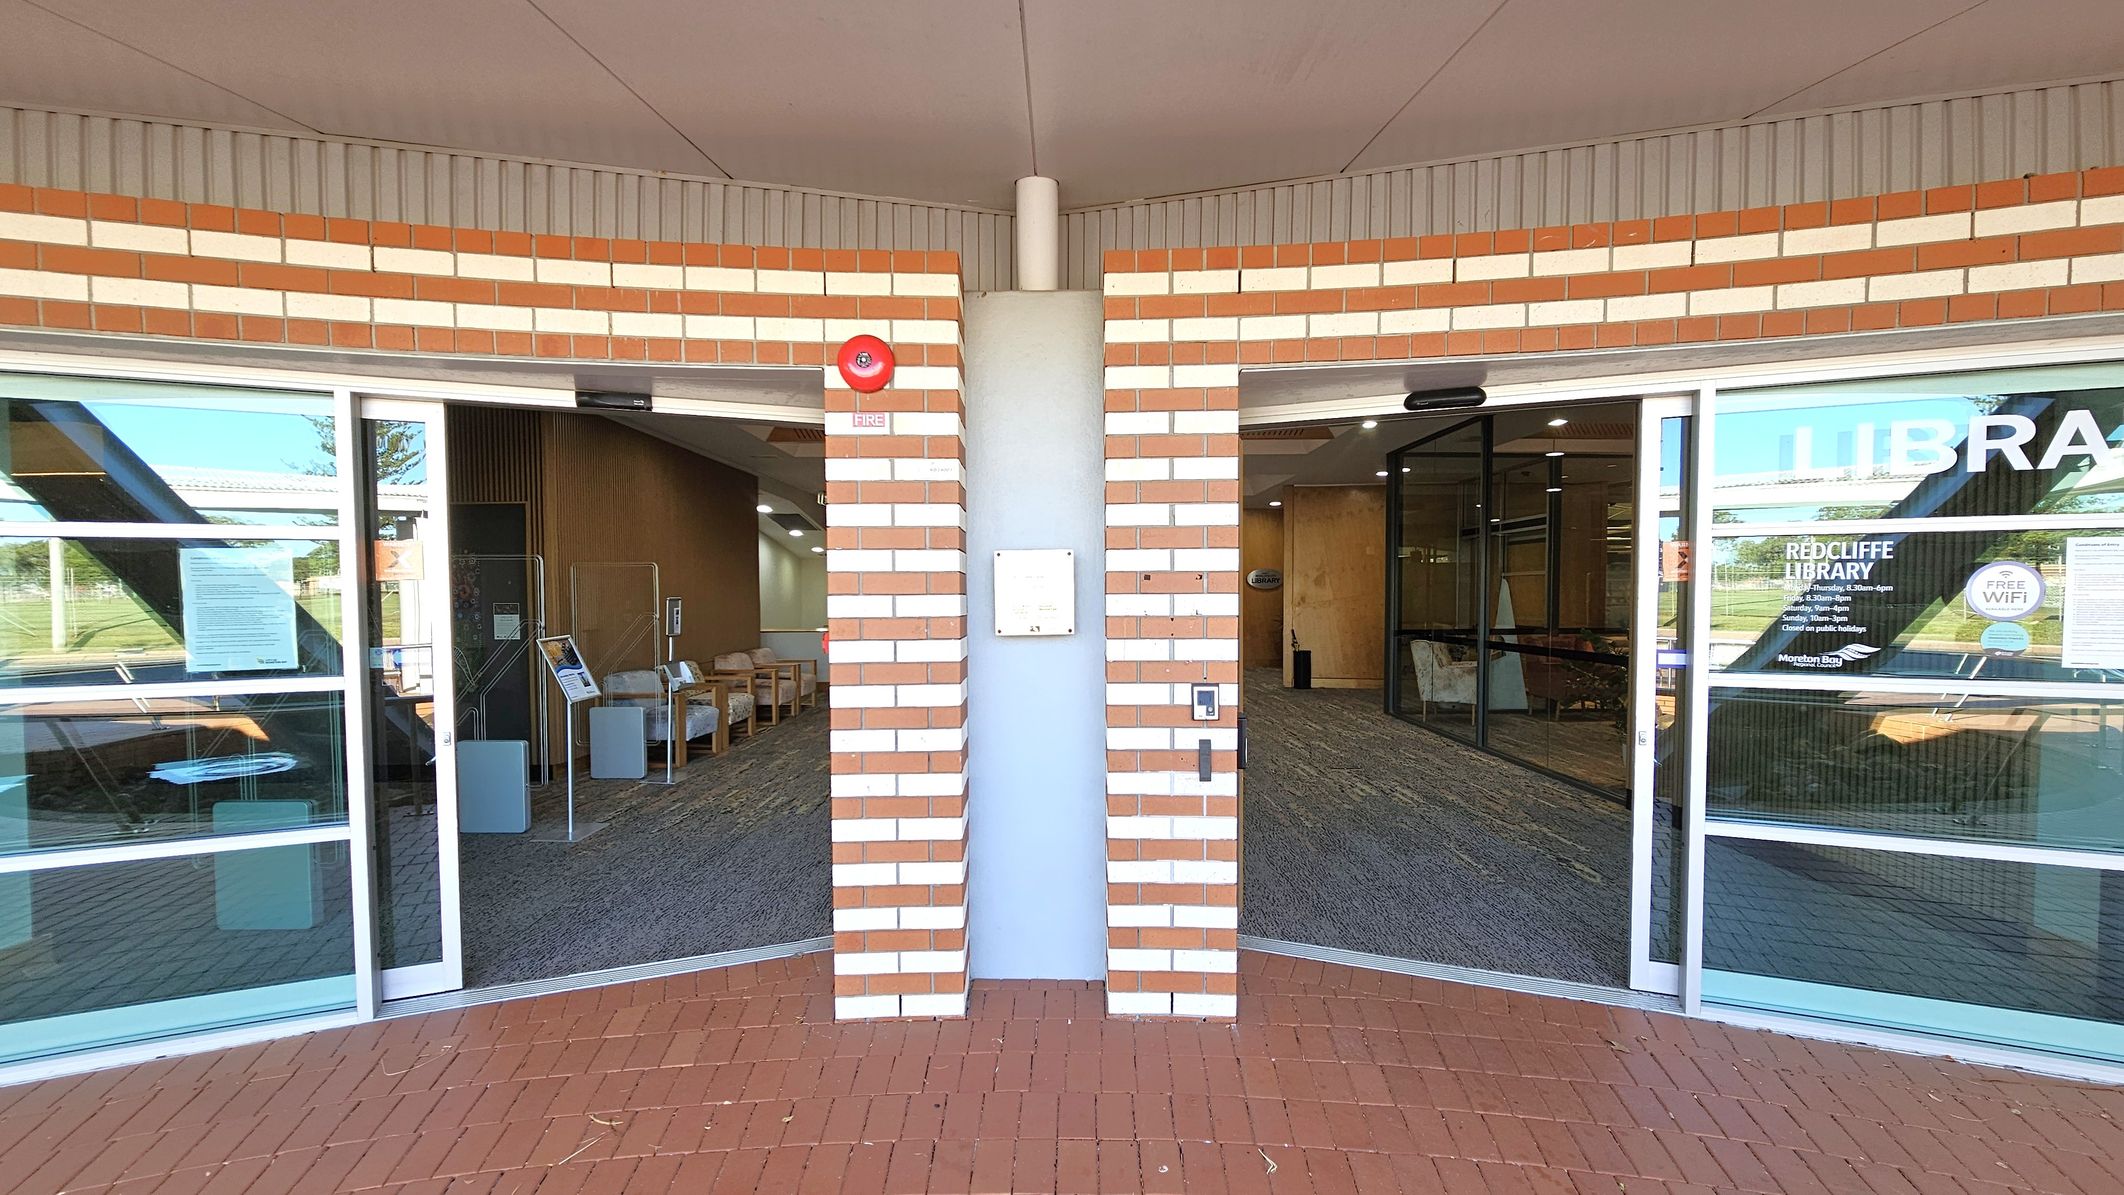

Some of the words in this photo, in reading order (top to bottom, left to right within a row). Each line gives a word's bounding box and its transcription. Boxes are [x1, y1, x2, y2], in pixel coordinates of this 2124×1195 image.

[854, 413, 884, 427] FIRE
[1785, 540, 1894, 560] REDCLIFFE
[1785, 562, 1875, 580] LIBRARY
[1986, 580, 2026, 590] FREE
[1783, 594, 1804, 603] Friday,
[1982, 591, 2028, 604] WiFi
[1782, 604, 1813, 613] Saturday,
[1782, 614, 1808, 623] Sunday,
[1782, 624, 1804, 632] Closed
[1816, 625, 1837, 633] public
[1838, 624, 1867, 634] holidays
[1778, 654, 1820, 663] Moreton
[1821, 655, 1843, 667] Bay
